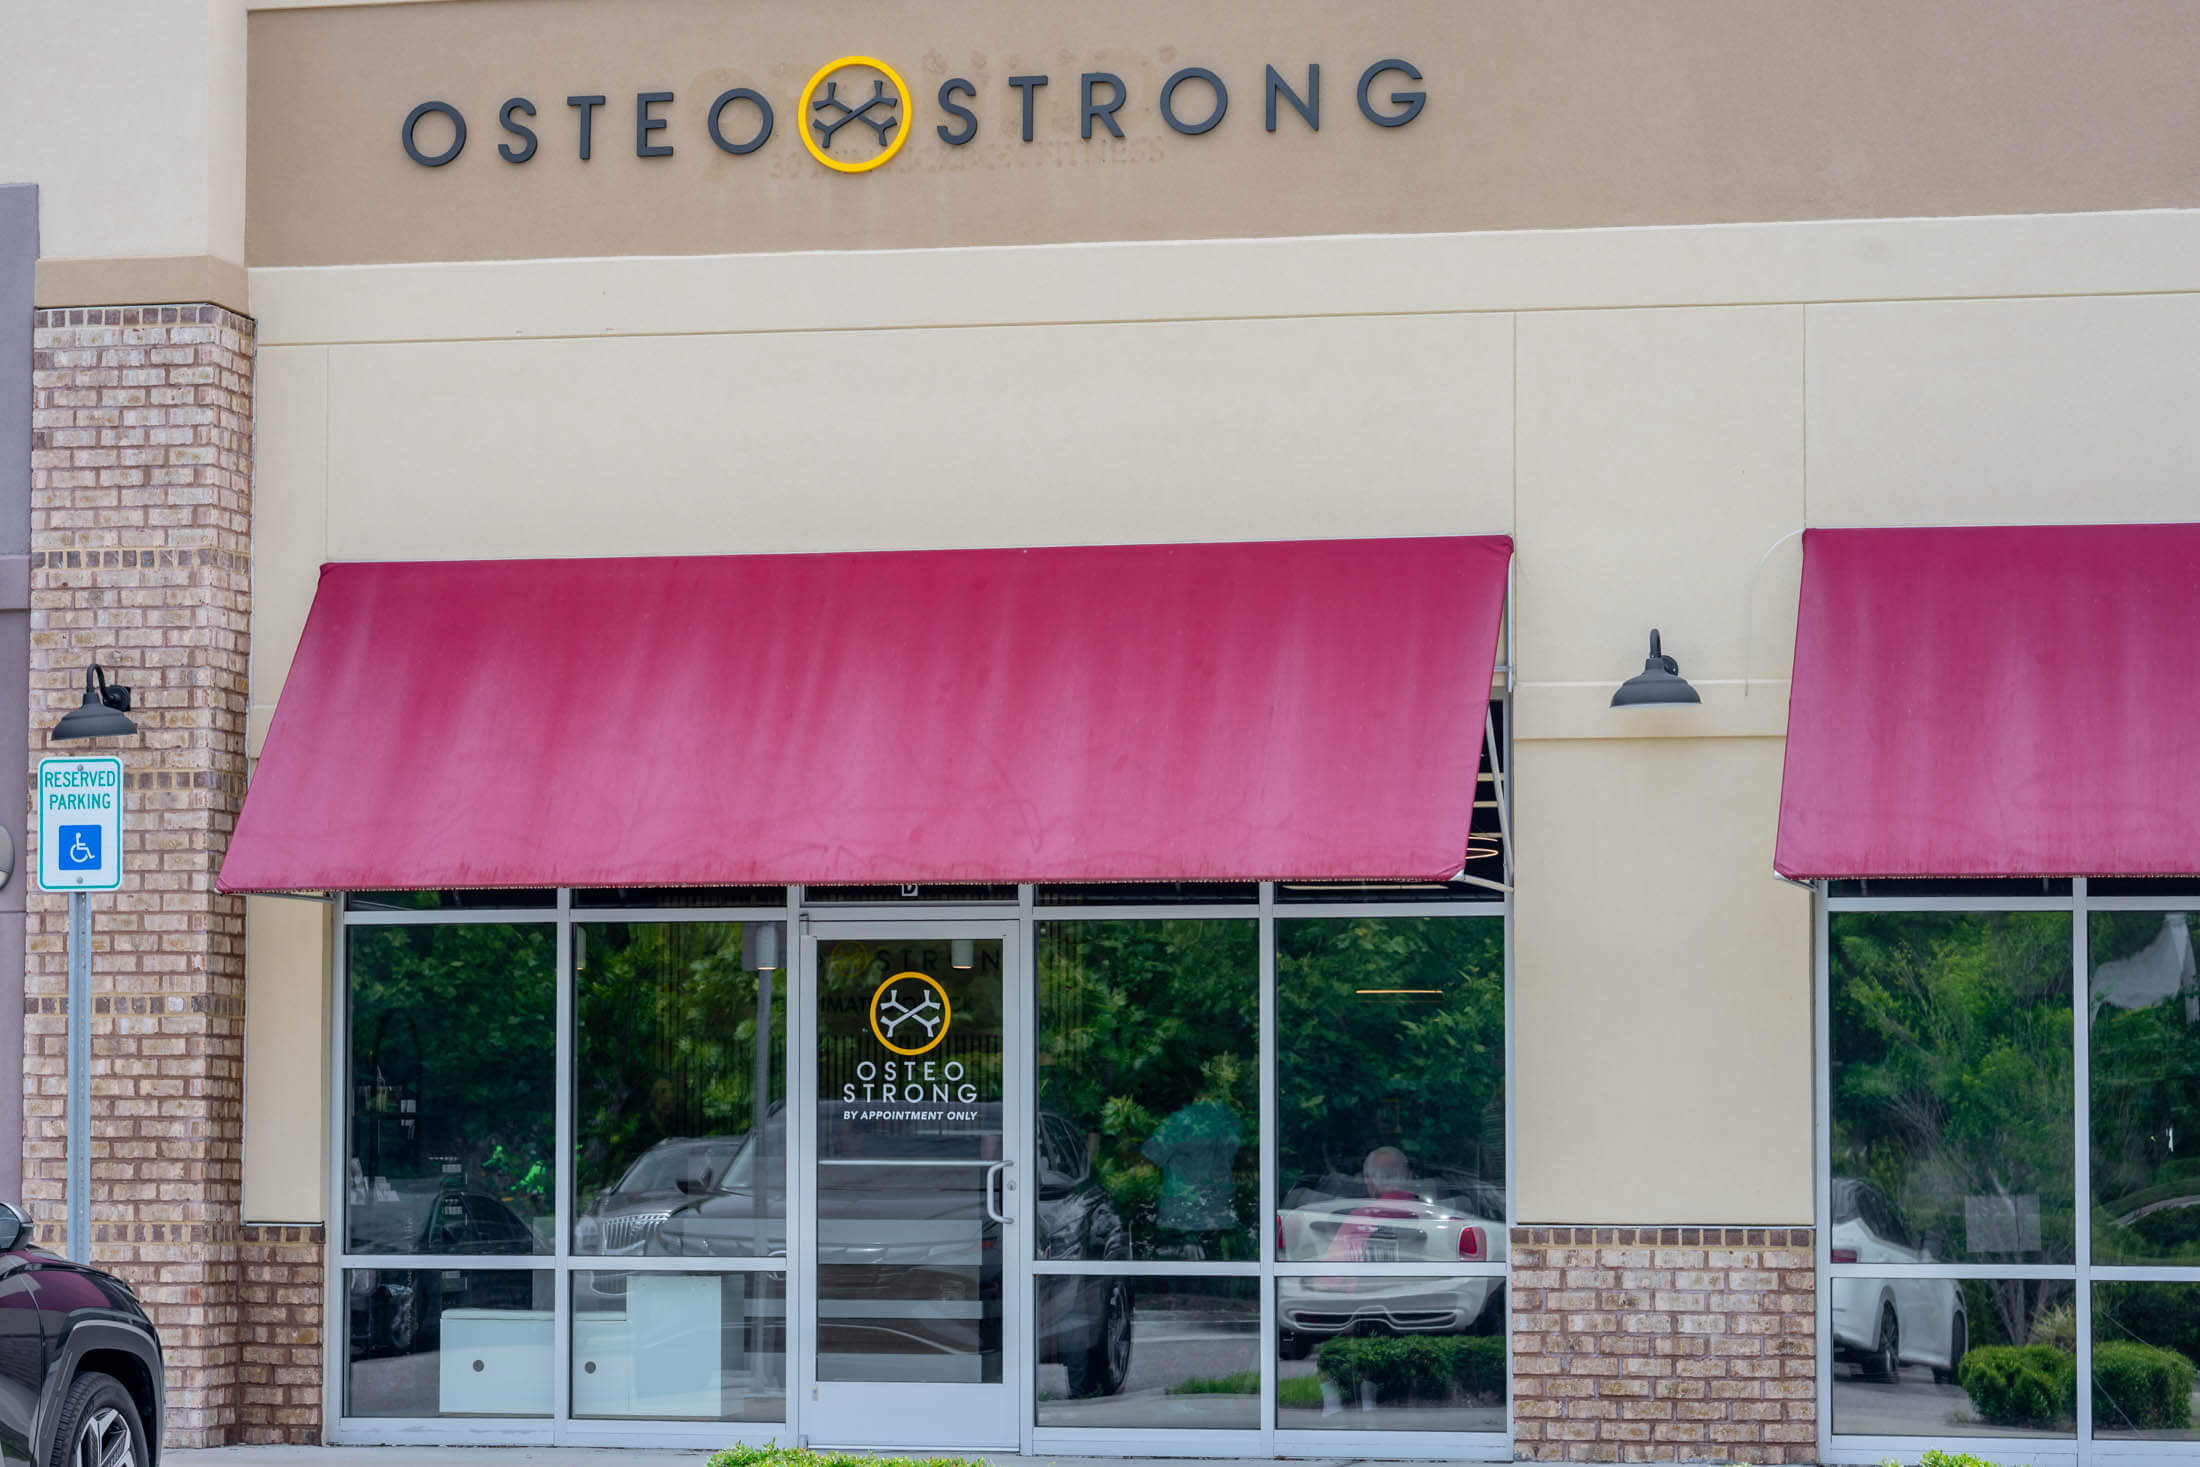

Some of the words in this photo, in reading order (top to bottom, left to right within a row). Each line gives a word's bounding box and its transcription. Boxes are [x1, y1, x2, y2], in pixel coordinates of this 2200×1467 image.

[402, 88, 774, 167] OSTEO
[937, 59, 1426, 146] STRONG
[44, 770, 115, 788] RESERVED
[49, 793, 111, 810] PARKING
[856, 1061, 964, 1081] OSTEO
[843, 1083, 977, 1104] STRONG
[843, 1111, 859, 1120] BY
[860, 1111, 943, 1120] APPOINTMENT
[946, 1111, 978, 1121] ONLY
